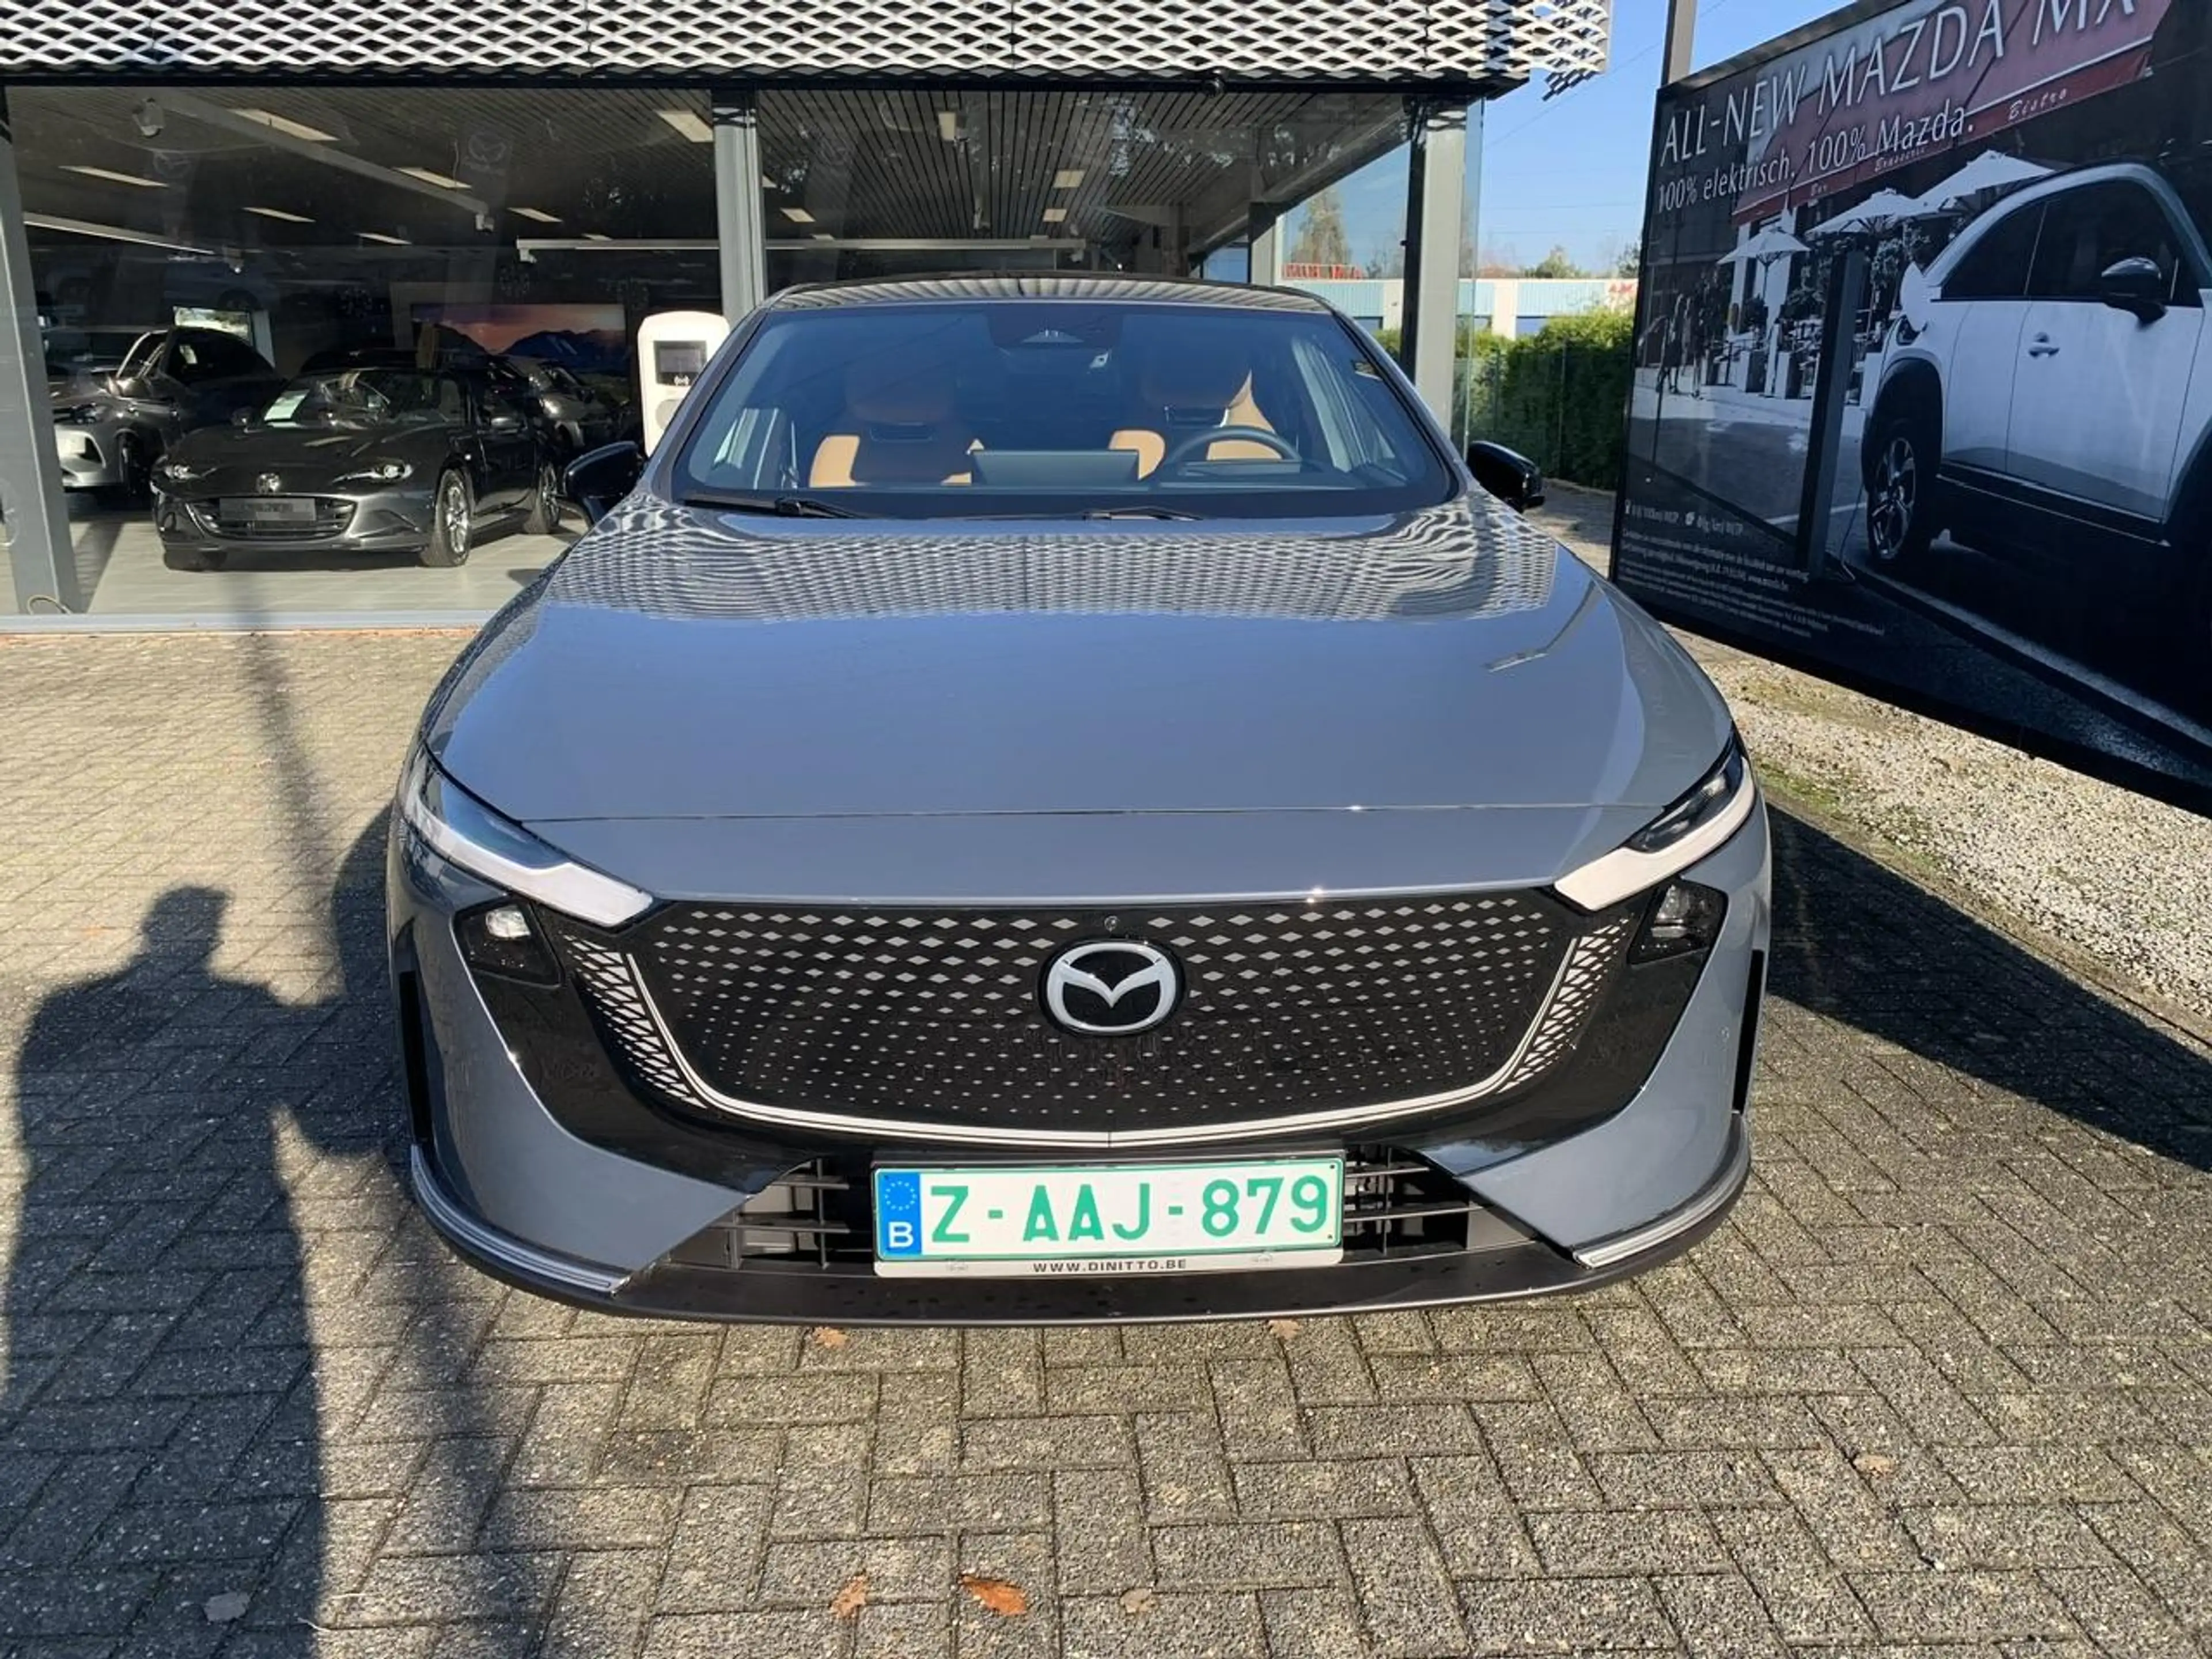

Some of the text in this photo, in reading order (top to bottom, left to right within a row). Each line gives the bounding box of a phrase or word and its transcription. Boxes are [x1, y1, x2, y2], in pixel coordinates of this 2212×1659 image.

[1660, 63, 1806, 167] ALL-NEW
[1817, 0, 2004, 115] MAZDA
[1658, 98, 1974, 214] 100% elektrisch. 100% Mazda.
[888, 1175, 1328, 1248] B Z-AAJ-879
[1033, 1259, 1187, 1272] WWW.DINITTO.BE
